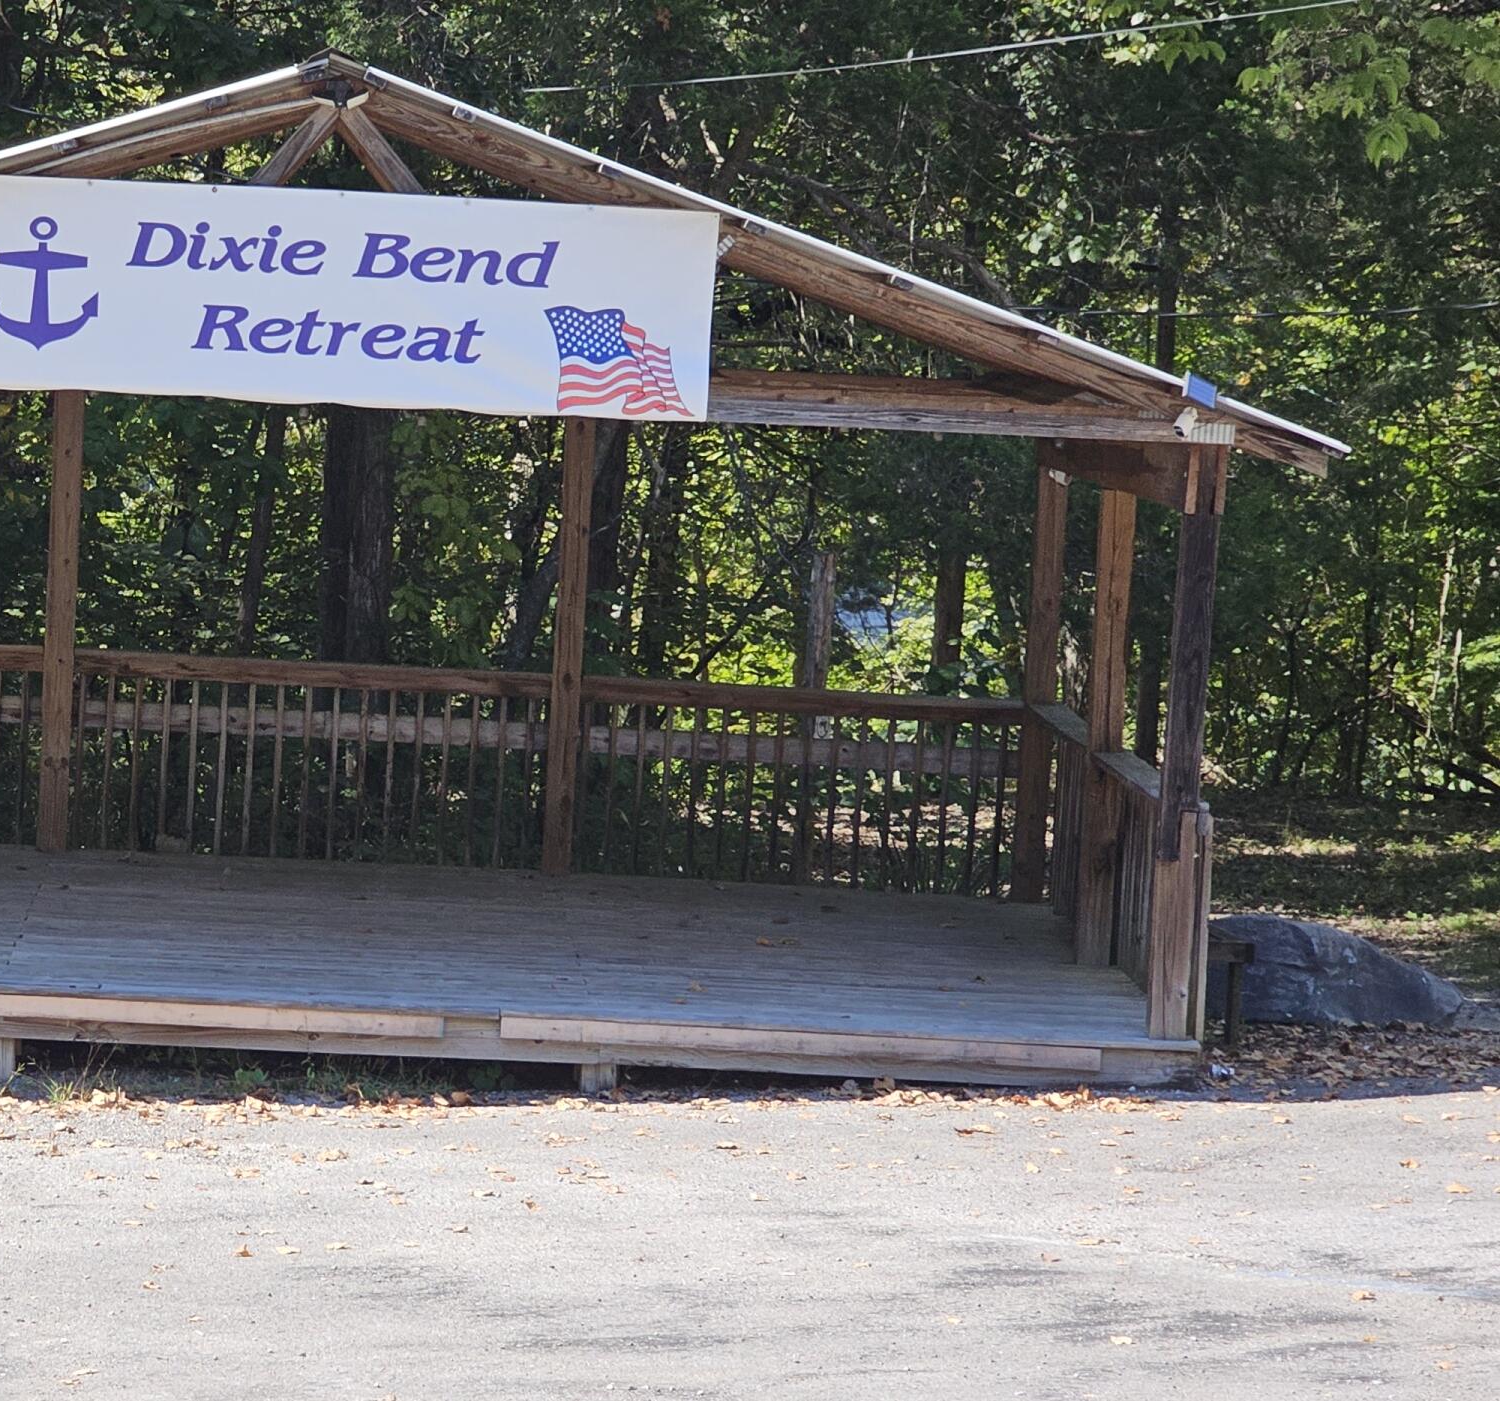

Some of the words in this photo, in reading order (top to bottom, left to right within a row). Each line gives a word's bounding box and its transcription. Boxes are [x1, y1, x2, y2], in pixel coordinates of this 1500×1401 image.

[125, 221, 327, 276] Dixie
[351, 232, 561, 289] Bend
[190, 304, 486, 365] Retreat
